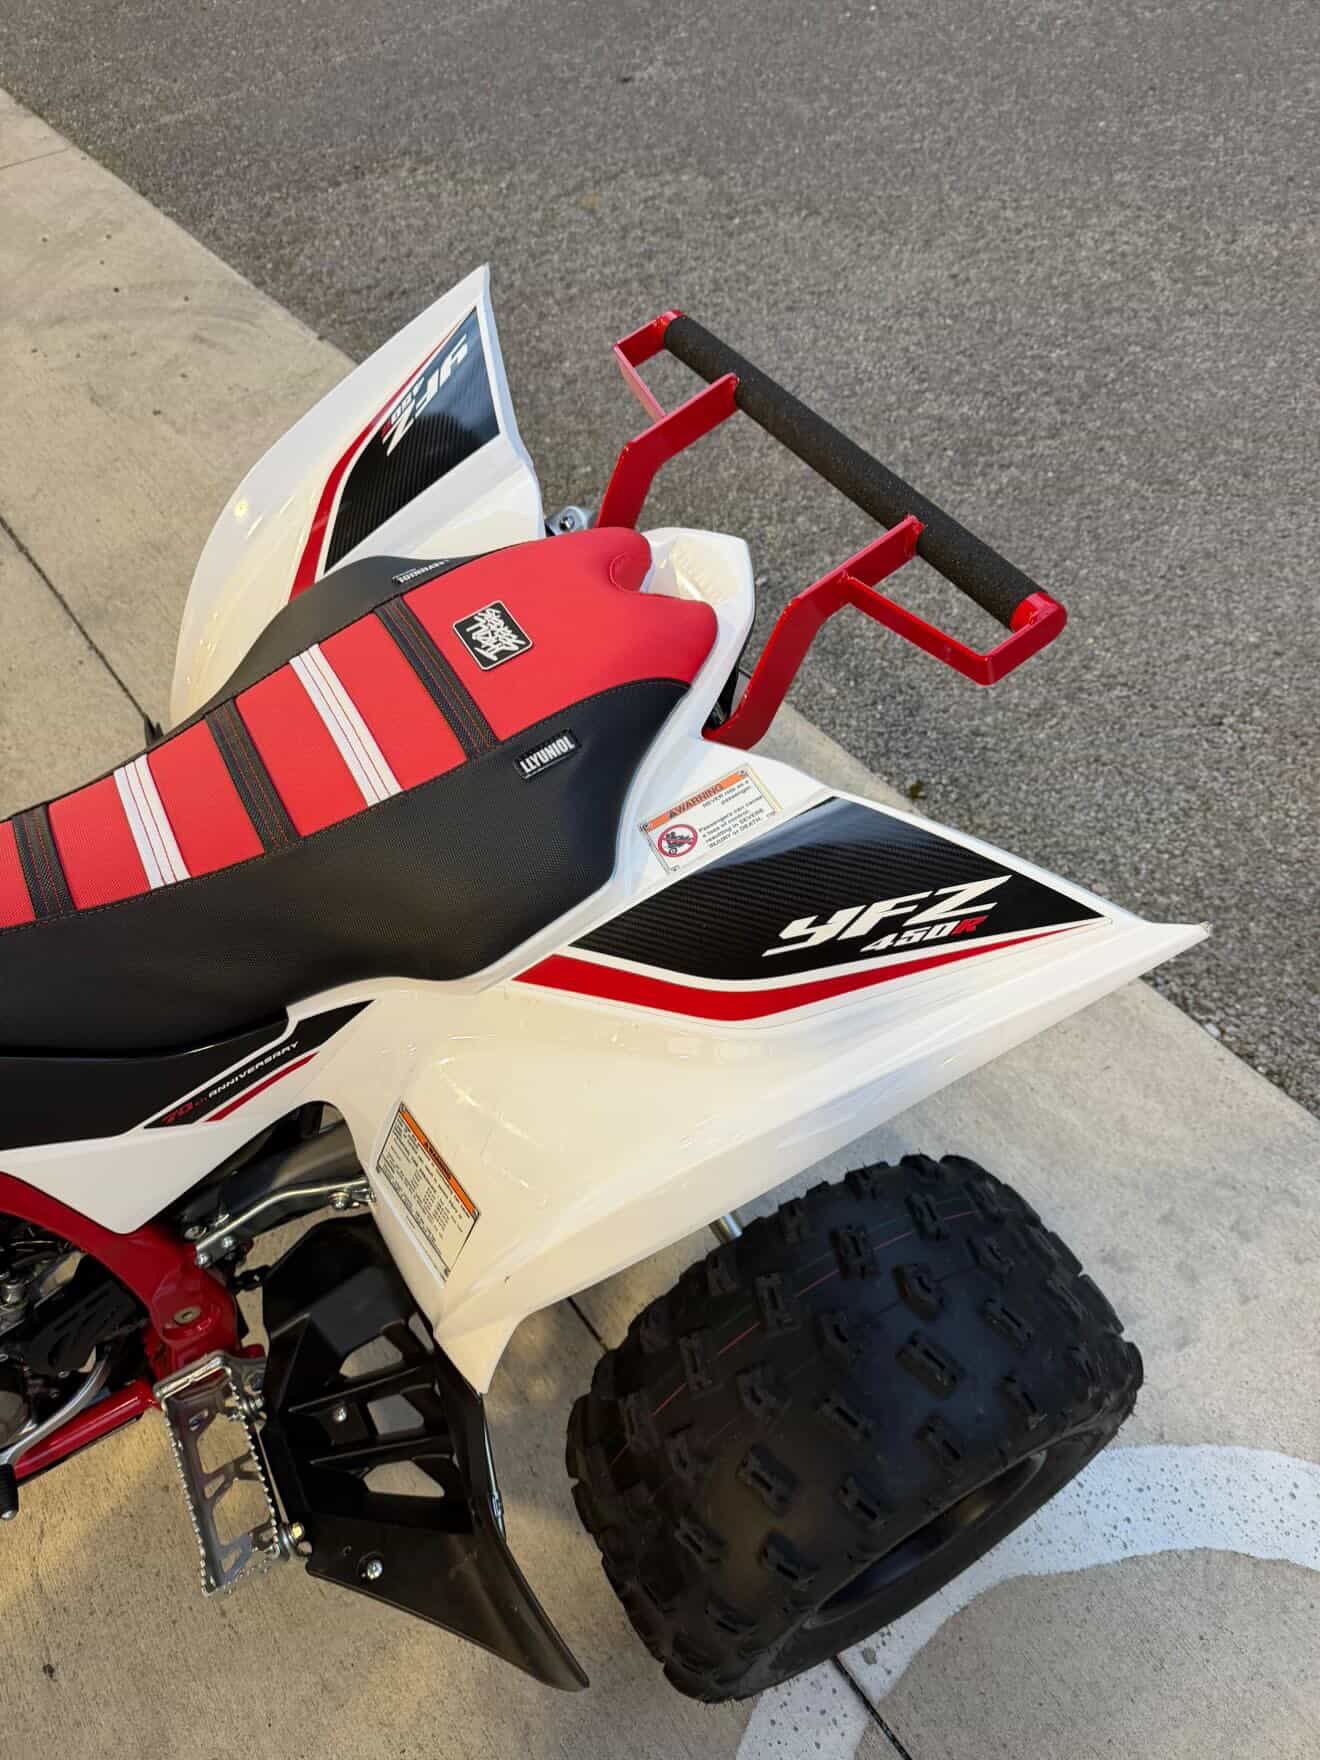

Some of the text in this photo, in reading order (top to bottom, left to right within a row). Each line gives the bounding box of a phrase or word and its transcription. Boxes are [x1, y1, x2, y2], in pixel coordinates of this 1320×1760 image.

[382, 333, 468, 456] YFZ
[675, 783, 723, 815] WARNING
[762, 875, 1012, 957] YFZ
[860, 915, 989, 952] 450R
[208, 1041, 299, 1098] ANNIVERSARY
